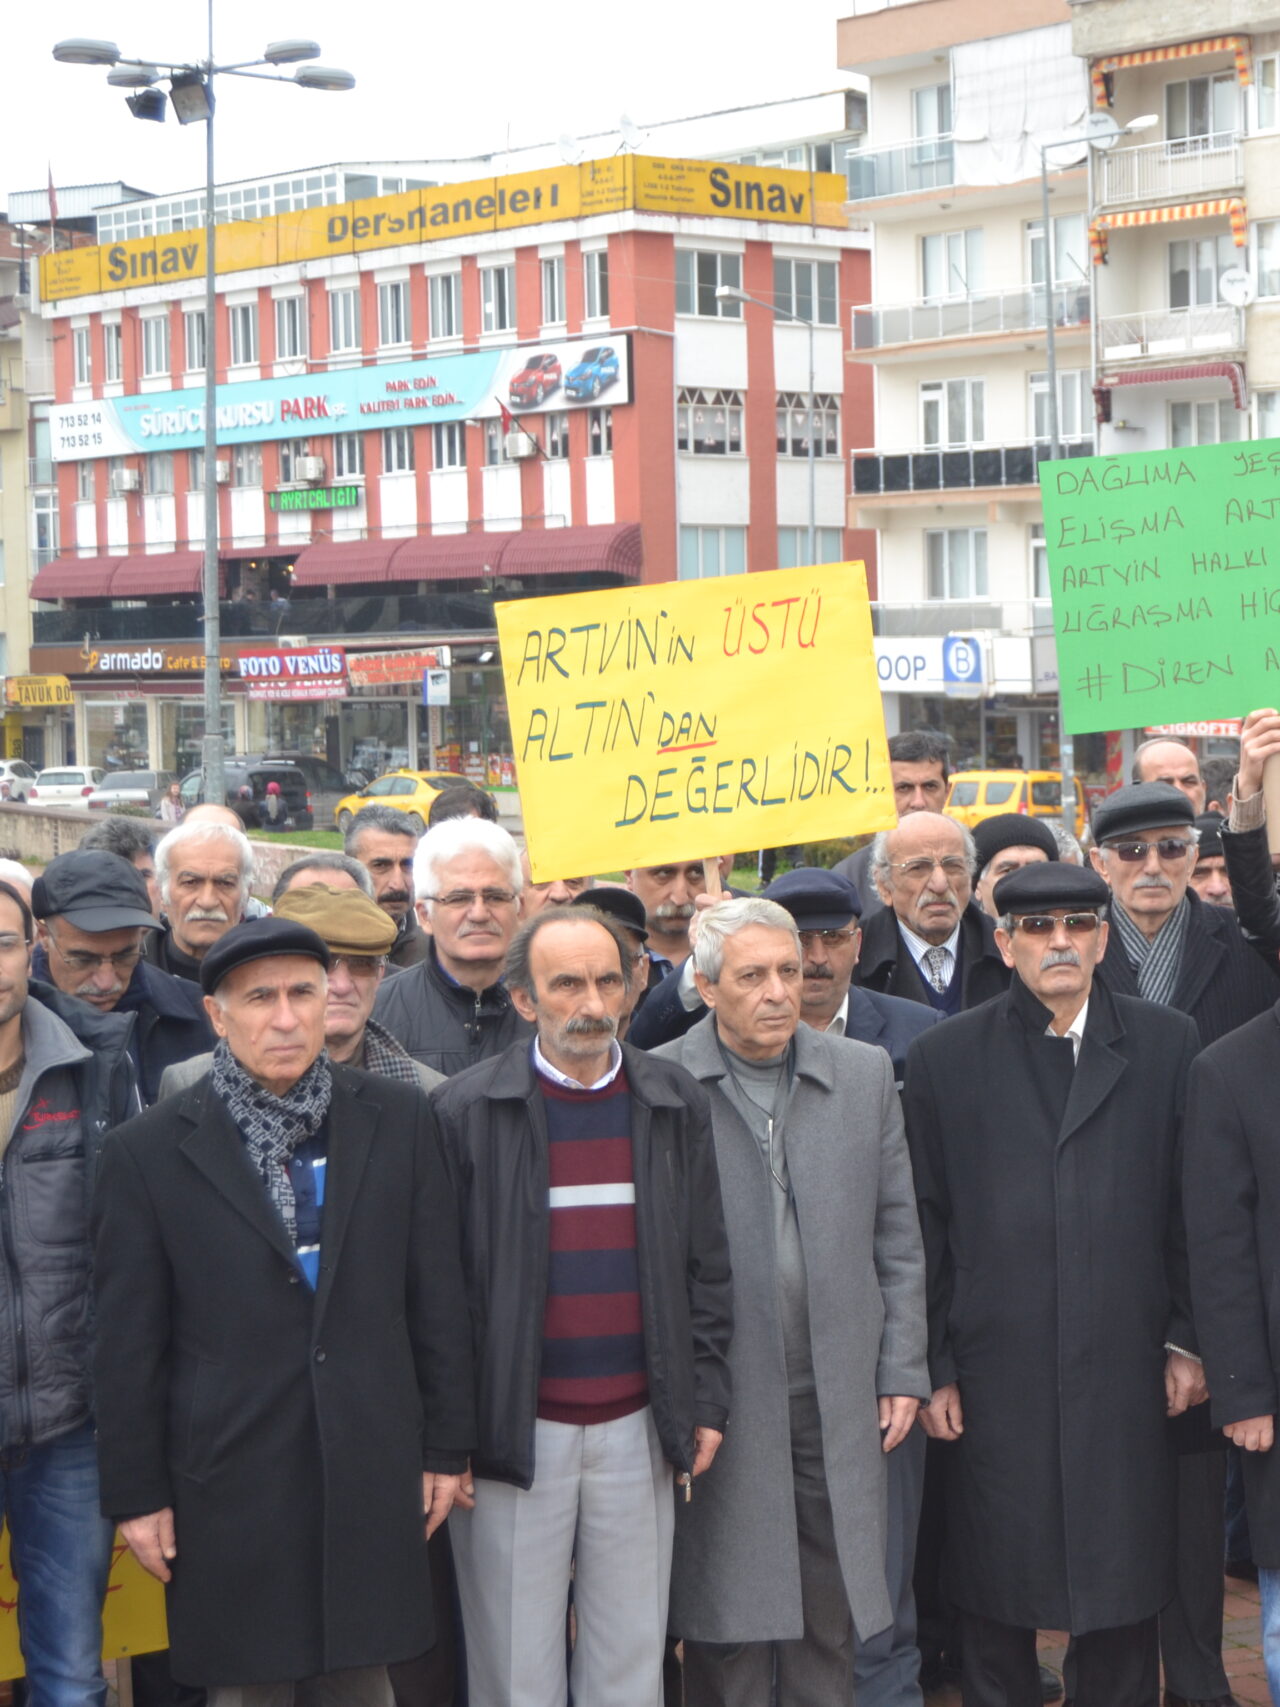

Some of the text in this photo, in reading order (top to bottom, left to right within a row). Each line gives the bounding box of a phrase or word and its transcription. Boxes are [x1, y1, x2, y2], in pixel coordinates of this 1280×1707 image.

[386, 378, 409, 392] PARK
[59, 412, 102, 428] 713 52 14
[280, 395, 329, 422] PARK
[60, 432, 103, 448] 713 52 15
[1062, 556, 1162, 593] ARTVİN
[1191, 546, 1268, 576] HALKI
[722, 587, 823, 657] ÜSTÜ
[238, 655, 282, 677] FOTO
[284, 648, 343, 675] VENÜS
